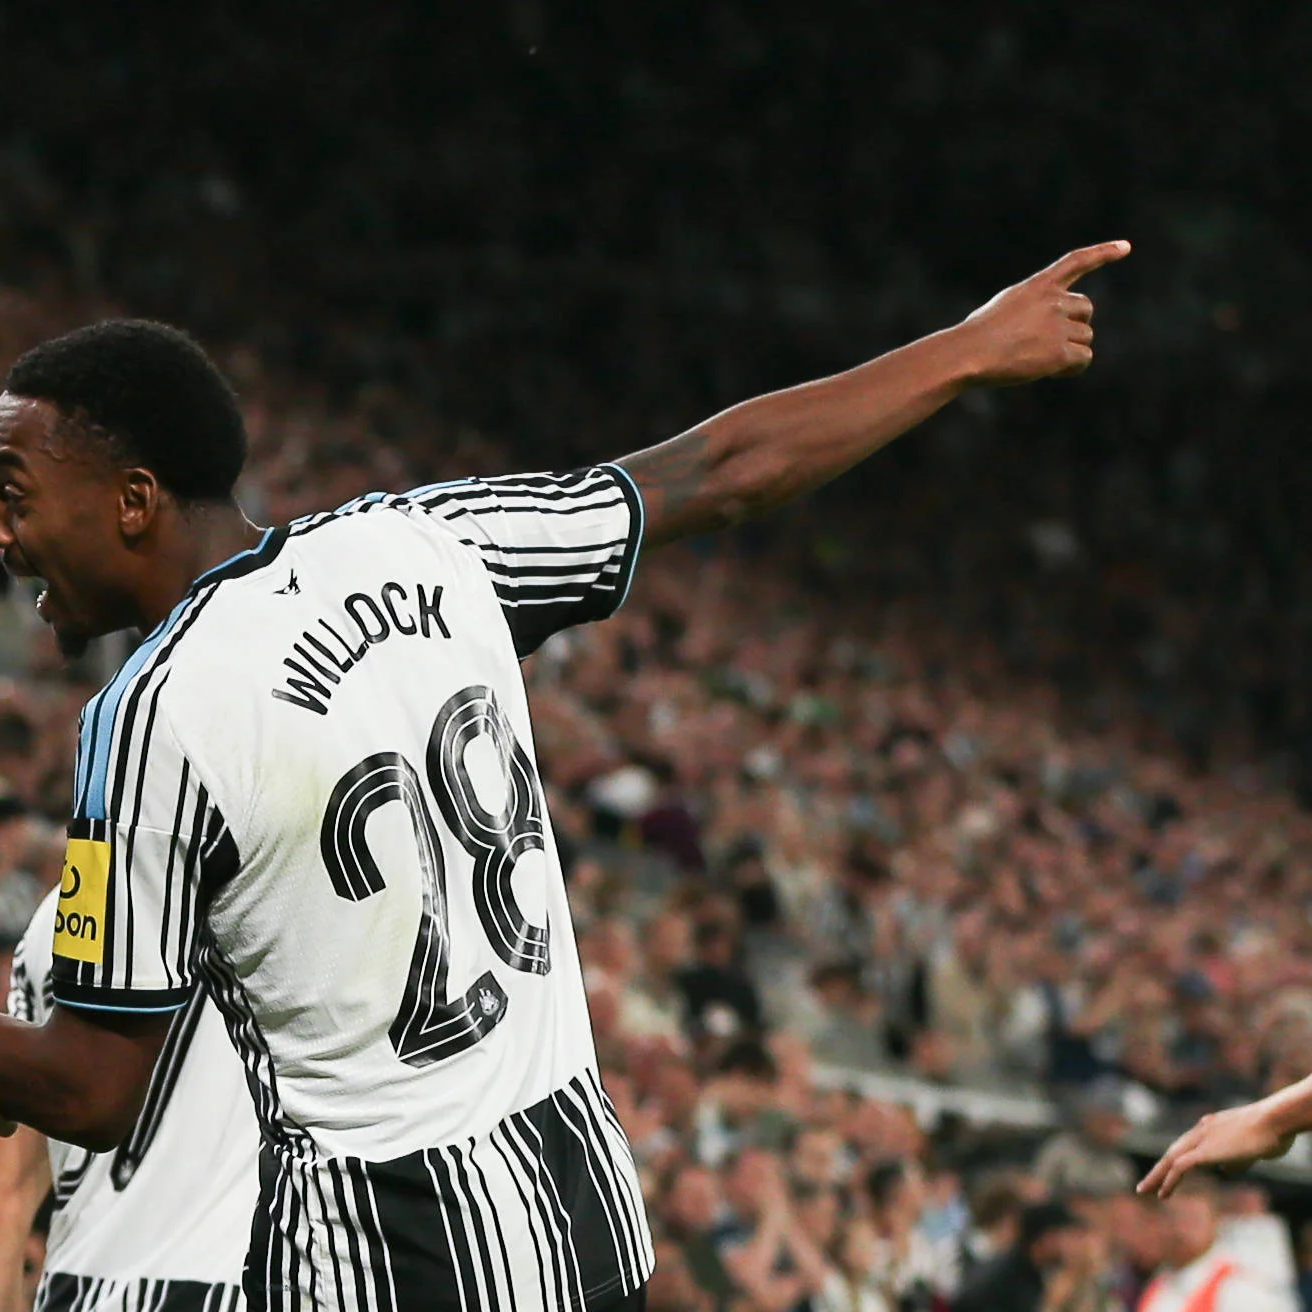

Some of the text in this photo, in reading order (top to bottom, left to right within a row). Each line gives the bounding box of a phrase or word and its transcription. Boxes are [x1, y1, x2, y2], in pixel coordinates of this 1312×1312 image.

[271, 582, 450, 715] WILLOCK
[54, 909, 97, 941] oon
[320, 685, 551, 1068] 28
